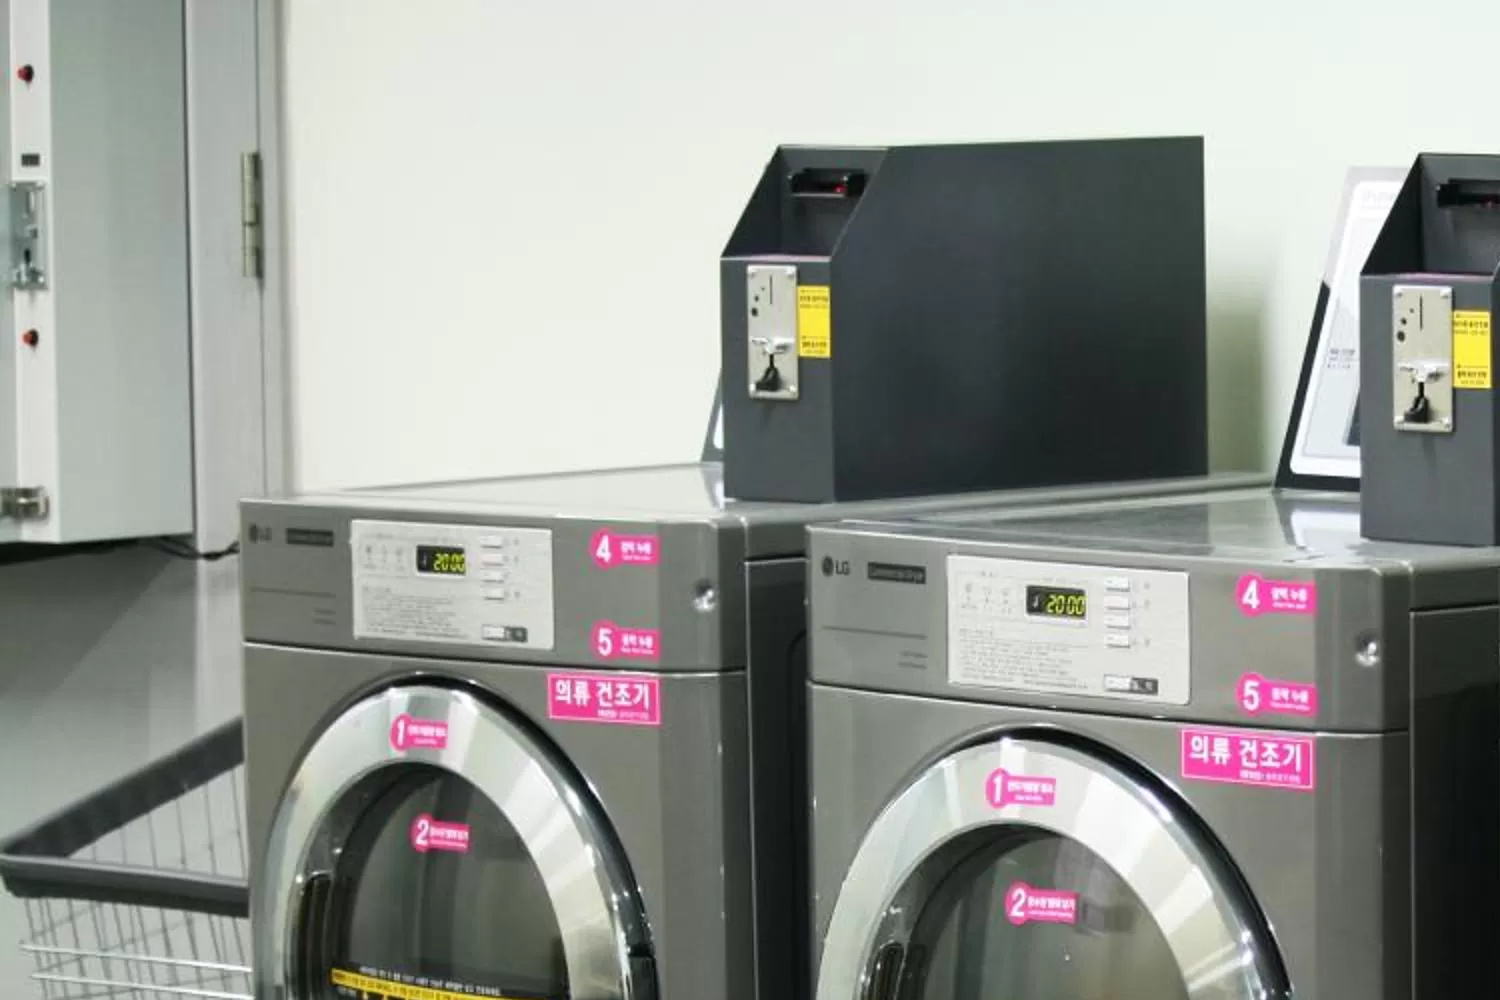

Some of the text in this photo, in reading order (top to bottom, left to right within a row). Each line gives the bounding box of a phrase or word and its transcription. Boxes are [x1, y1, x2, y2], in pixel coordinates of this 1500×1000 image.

[595, 534, 612, 563] 4
[1241, 578, 1261, 610] 4
[597, 627, 613, 656] 5
[555, 678, 650, 711] 의류 건조기
[1243, 680, 1260, 711] 5
[396, 719, 406, 747] 1
[1189, 735, 1302, 773] 의류 건조기
[992, 771, 1003, 804] 1
[415, 819, 430, 847] 2
[1010, 887, 1027, 920] 2
